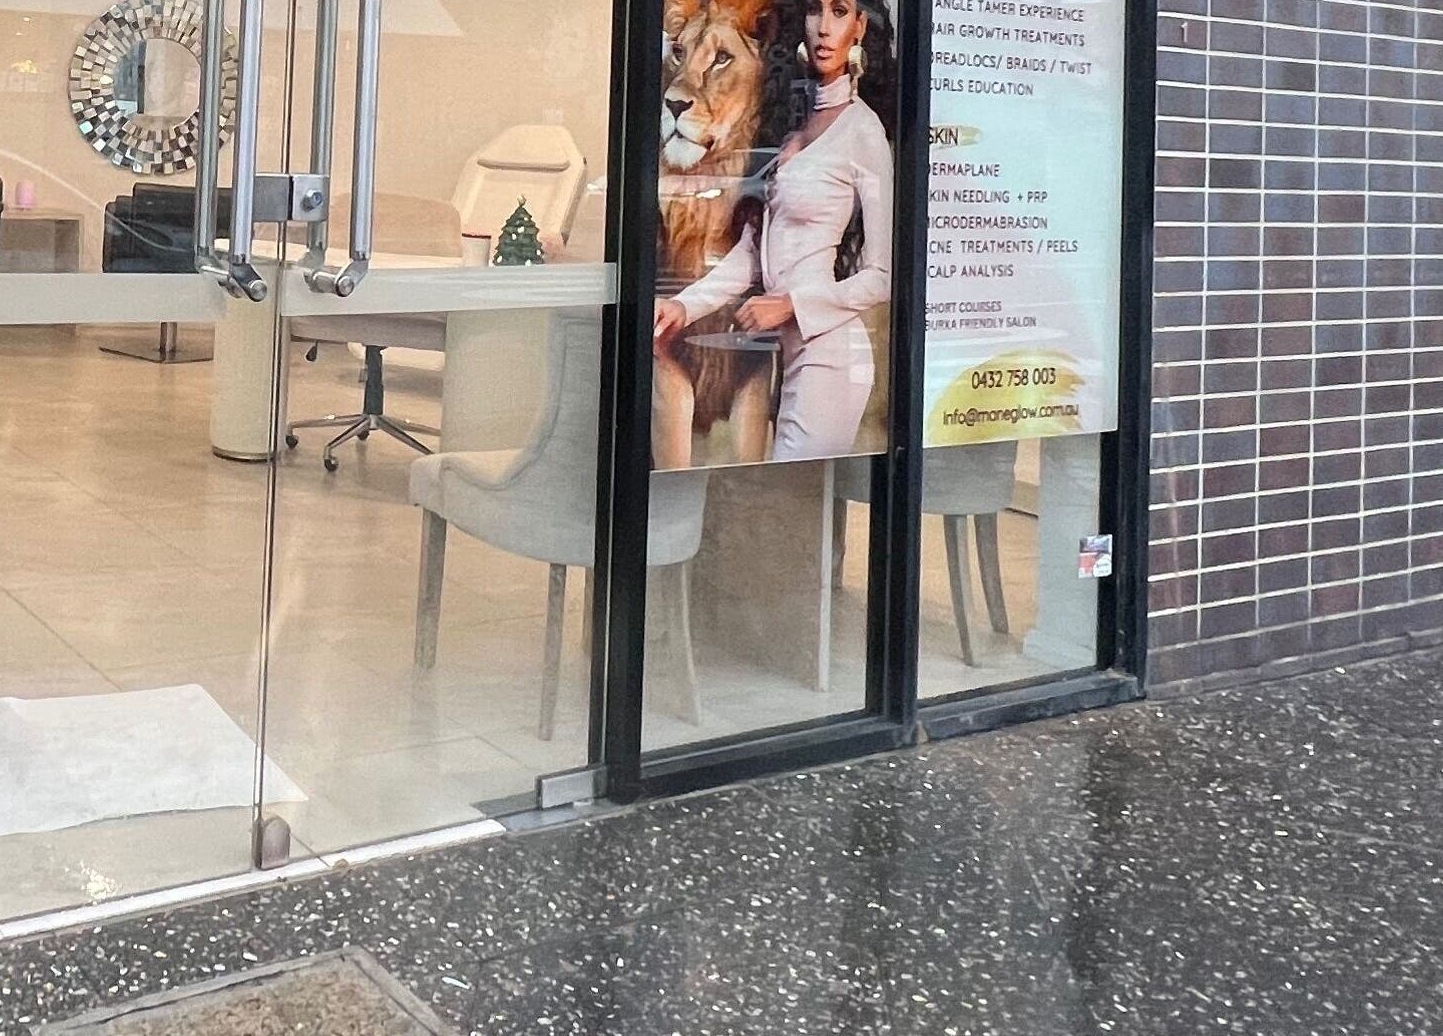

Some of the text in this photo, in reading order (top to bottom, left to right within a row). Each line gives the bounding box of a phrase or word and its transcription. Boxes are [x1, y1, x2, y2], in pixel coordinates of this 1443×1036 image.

[978, 0, 1016, 15] TAMER
[1020, 4, 1085, 22] EXPERIENCE
[959, 24, 1010, 41] GROWTH
[1015, 28, 1085, 47] TREATMENTS
[1007, 57, 1046, 72] BRAIDS
[1060, 60, 1093, 75] TWIST
[968, 80, 1035, 96] EDUCATION
[929, 126, 959, 146] SKIN
[929, 162, 1000, 177] ERMAPLANE
[929, 189, 949, 203] KIN
[954, 190, 1010, 203] NEEDLING
[1027, 191, 1048, 203] PRP
[928, 215, 1048, 229] ICRODERMABRASION
[928, 240, 952, 254] CNE
[961, 240, 1034, 253] TREATMENTS
[1046, 240, 1078, 253] PEELS
[928, 264, 1014, 278] CALP ANALYSIS
[959, 301, 1002, 313] COURSES
[1006, 316, 1037, 328] SALON
[971, 367, 1056, 389] 0432 758 003
